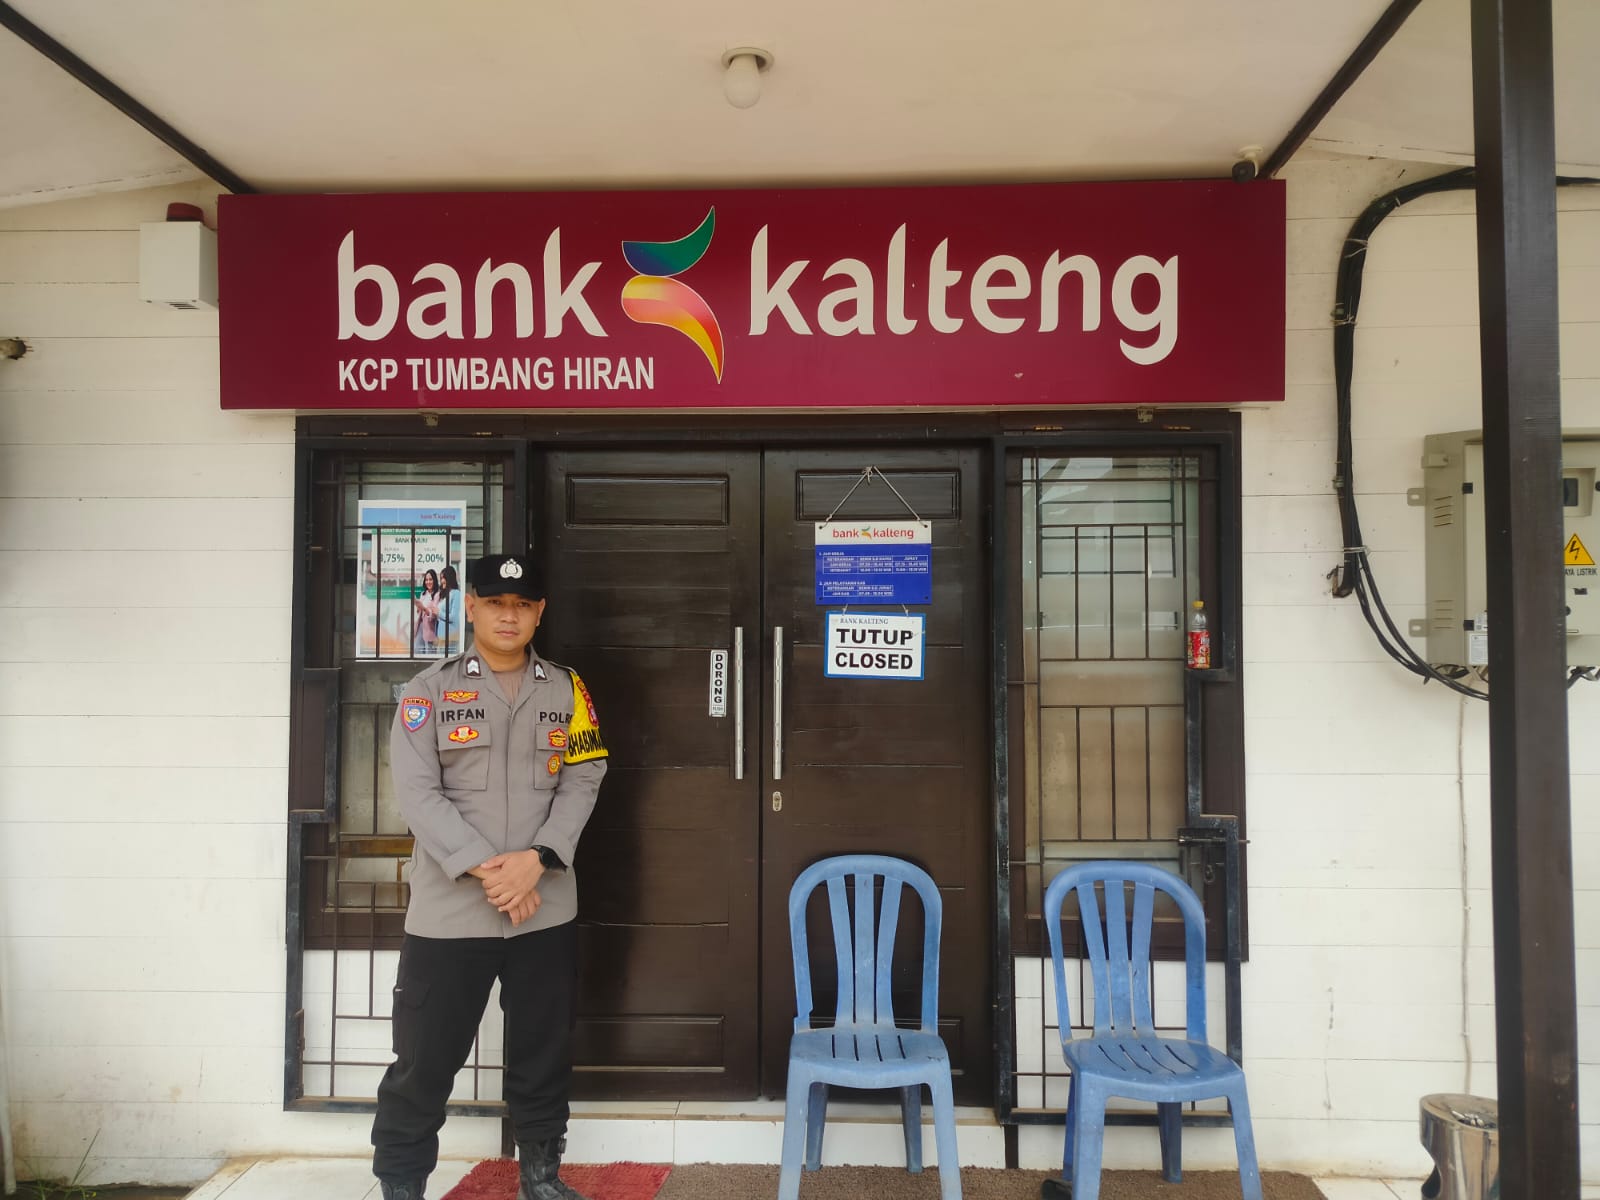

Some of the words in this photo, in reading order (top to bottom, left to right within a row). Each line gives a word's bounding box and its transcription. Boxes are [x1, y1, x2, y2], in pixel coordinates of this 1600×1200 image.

[337, 226, 609, 341] bank
[748, 222, 1179, 365] kalteng
[338, 359, 399, 392] KCP
[405, 358, 555, 391] TUMBANG
[563, 357, 655, 390] HIRAN
[832, 528, 860, 538] bank
[873, 528, 914, 539] kalteng
[417, 553, 444, 564] 2,00%
[1576, 567, 1598, 576] LISTRIK
[835, 628, 914, 646] TUTUP
[835, 652, 914, 670] CLOSED
[713, 654, 724, 704] DORONG
[440, 708, 485, 723] IRFAN
